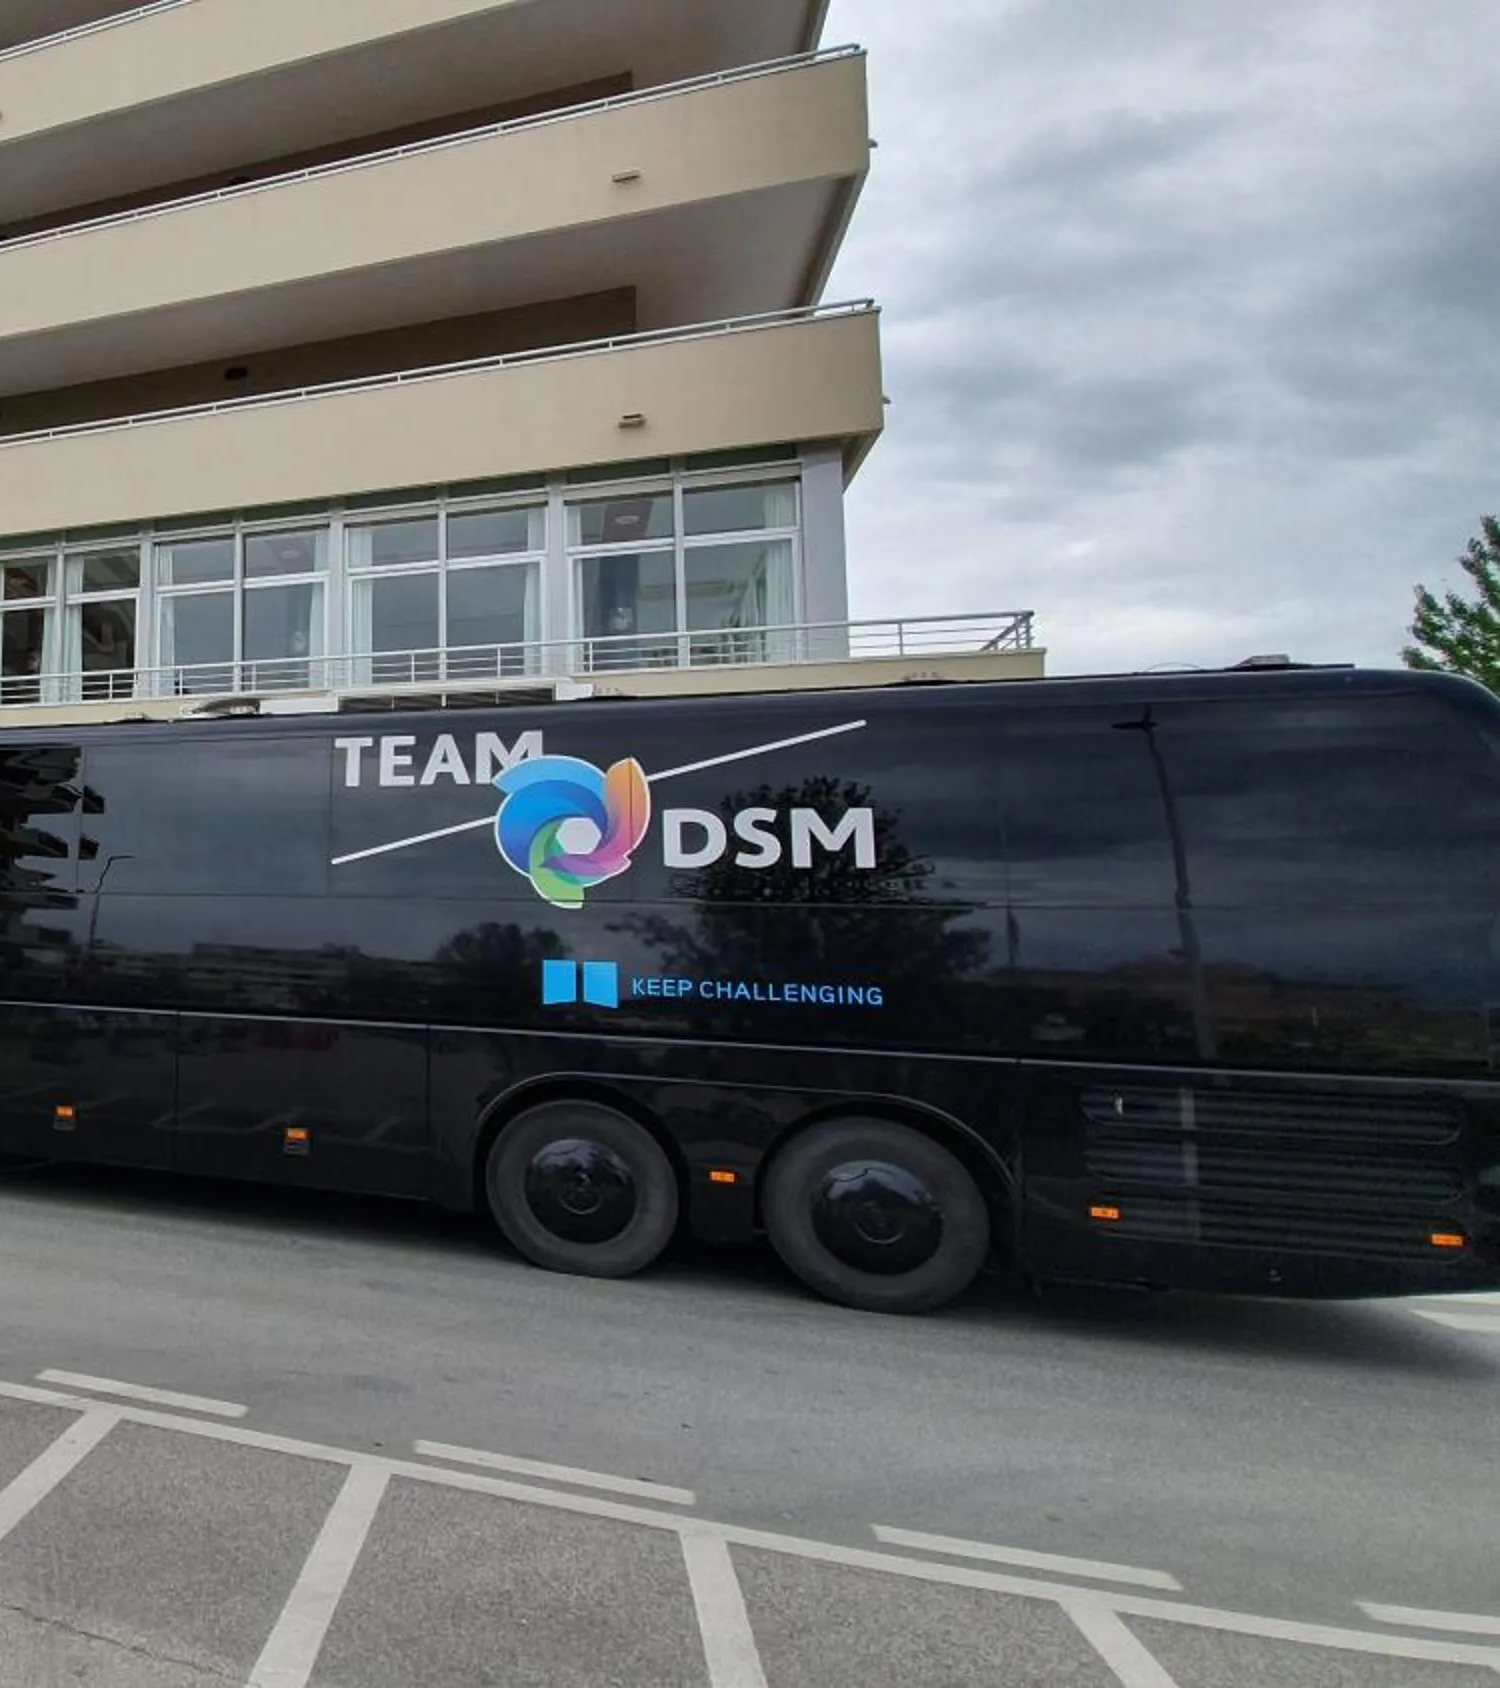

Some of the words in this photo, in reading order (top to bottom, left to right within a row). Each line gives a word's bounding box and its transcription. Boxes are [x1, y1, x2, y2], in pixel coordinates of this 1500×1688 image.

[335, 730, 543, 787] TEAM
[663, 807, 877, 869] DSM
[631, 977, 693, 998] KEEP
[699, 979, 884, 1006] CHALLENGING
